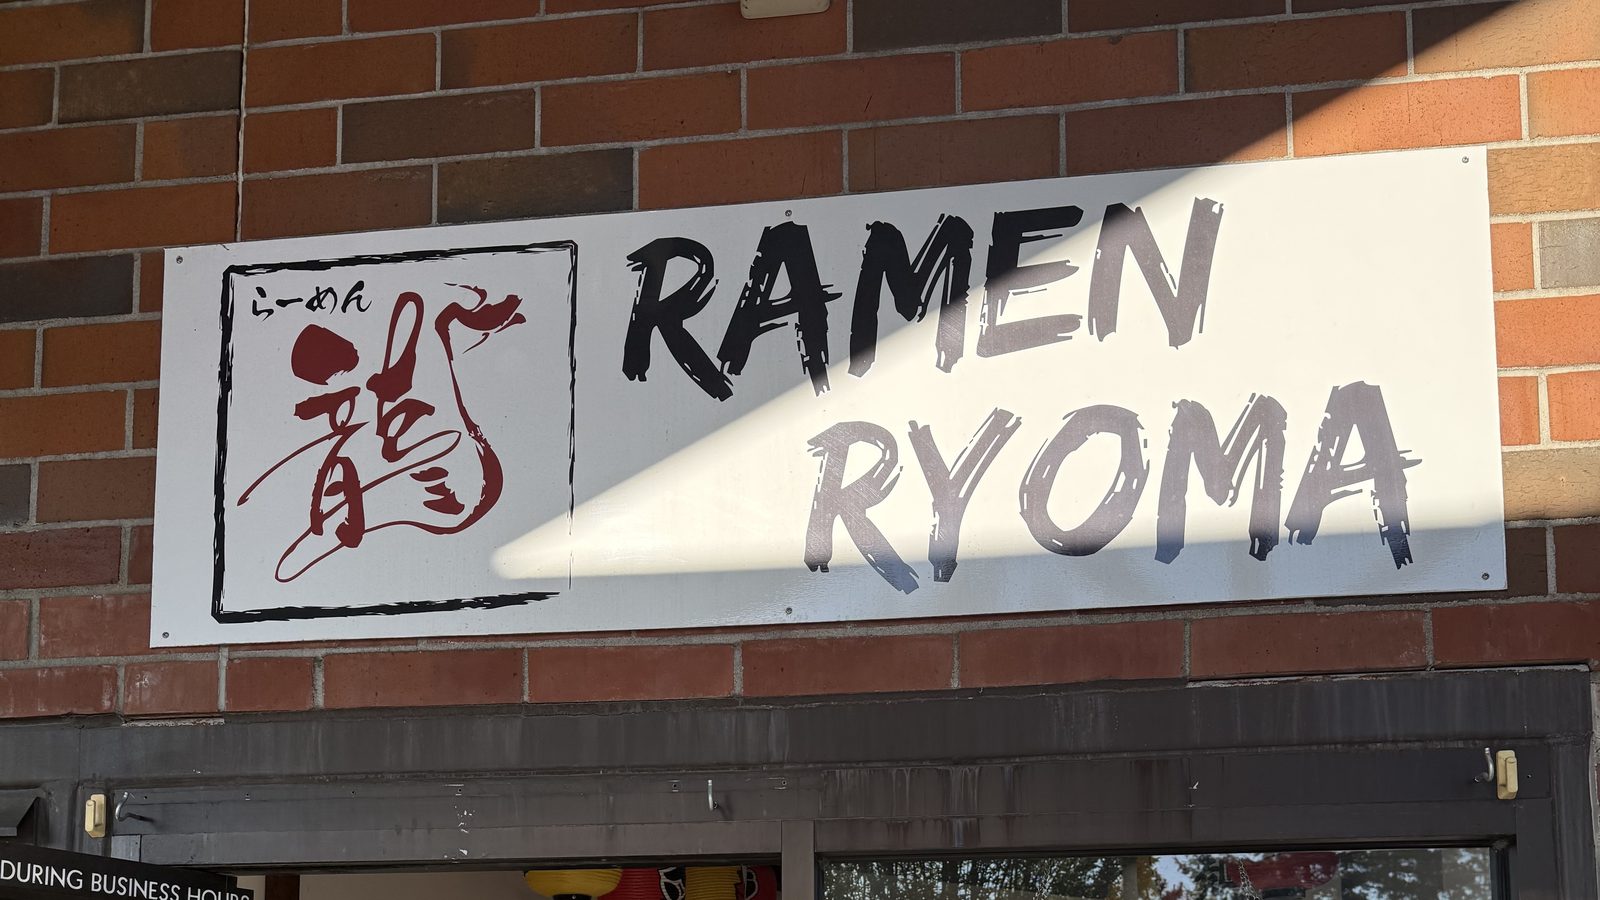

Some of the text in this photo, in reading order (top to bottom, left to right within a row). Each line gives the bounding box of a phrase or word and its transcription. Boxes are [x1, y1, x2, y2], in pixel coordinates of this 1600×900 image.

[251, 280, 373, 321] らーめん
[622, 196, 1223, 401] RAMEN
[804, 380, 1421, 594] RYOMA
[0, 859, 83, 889] DURING
[90, 872, 181, 900] BUSINESS
